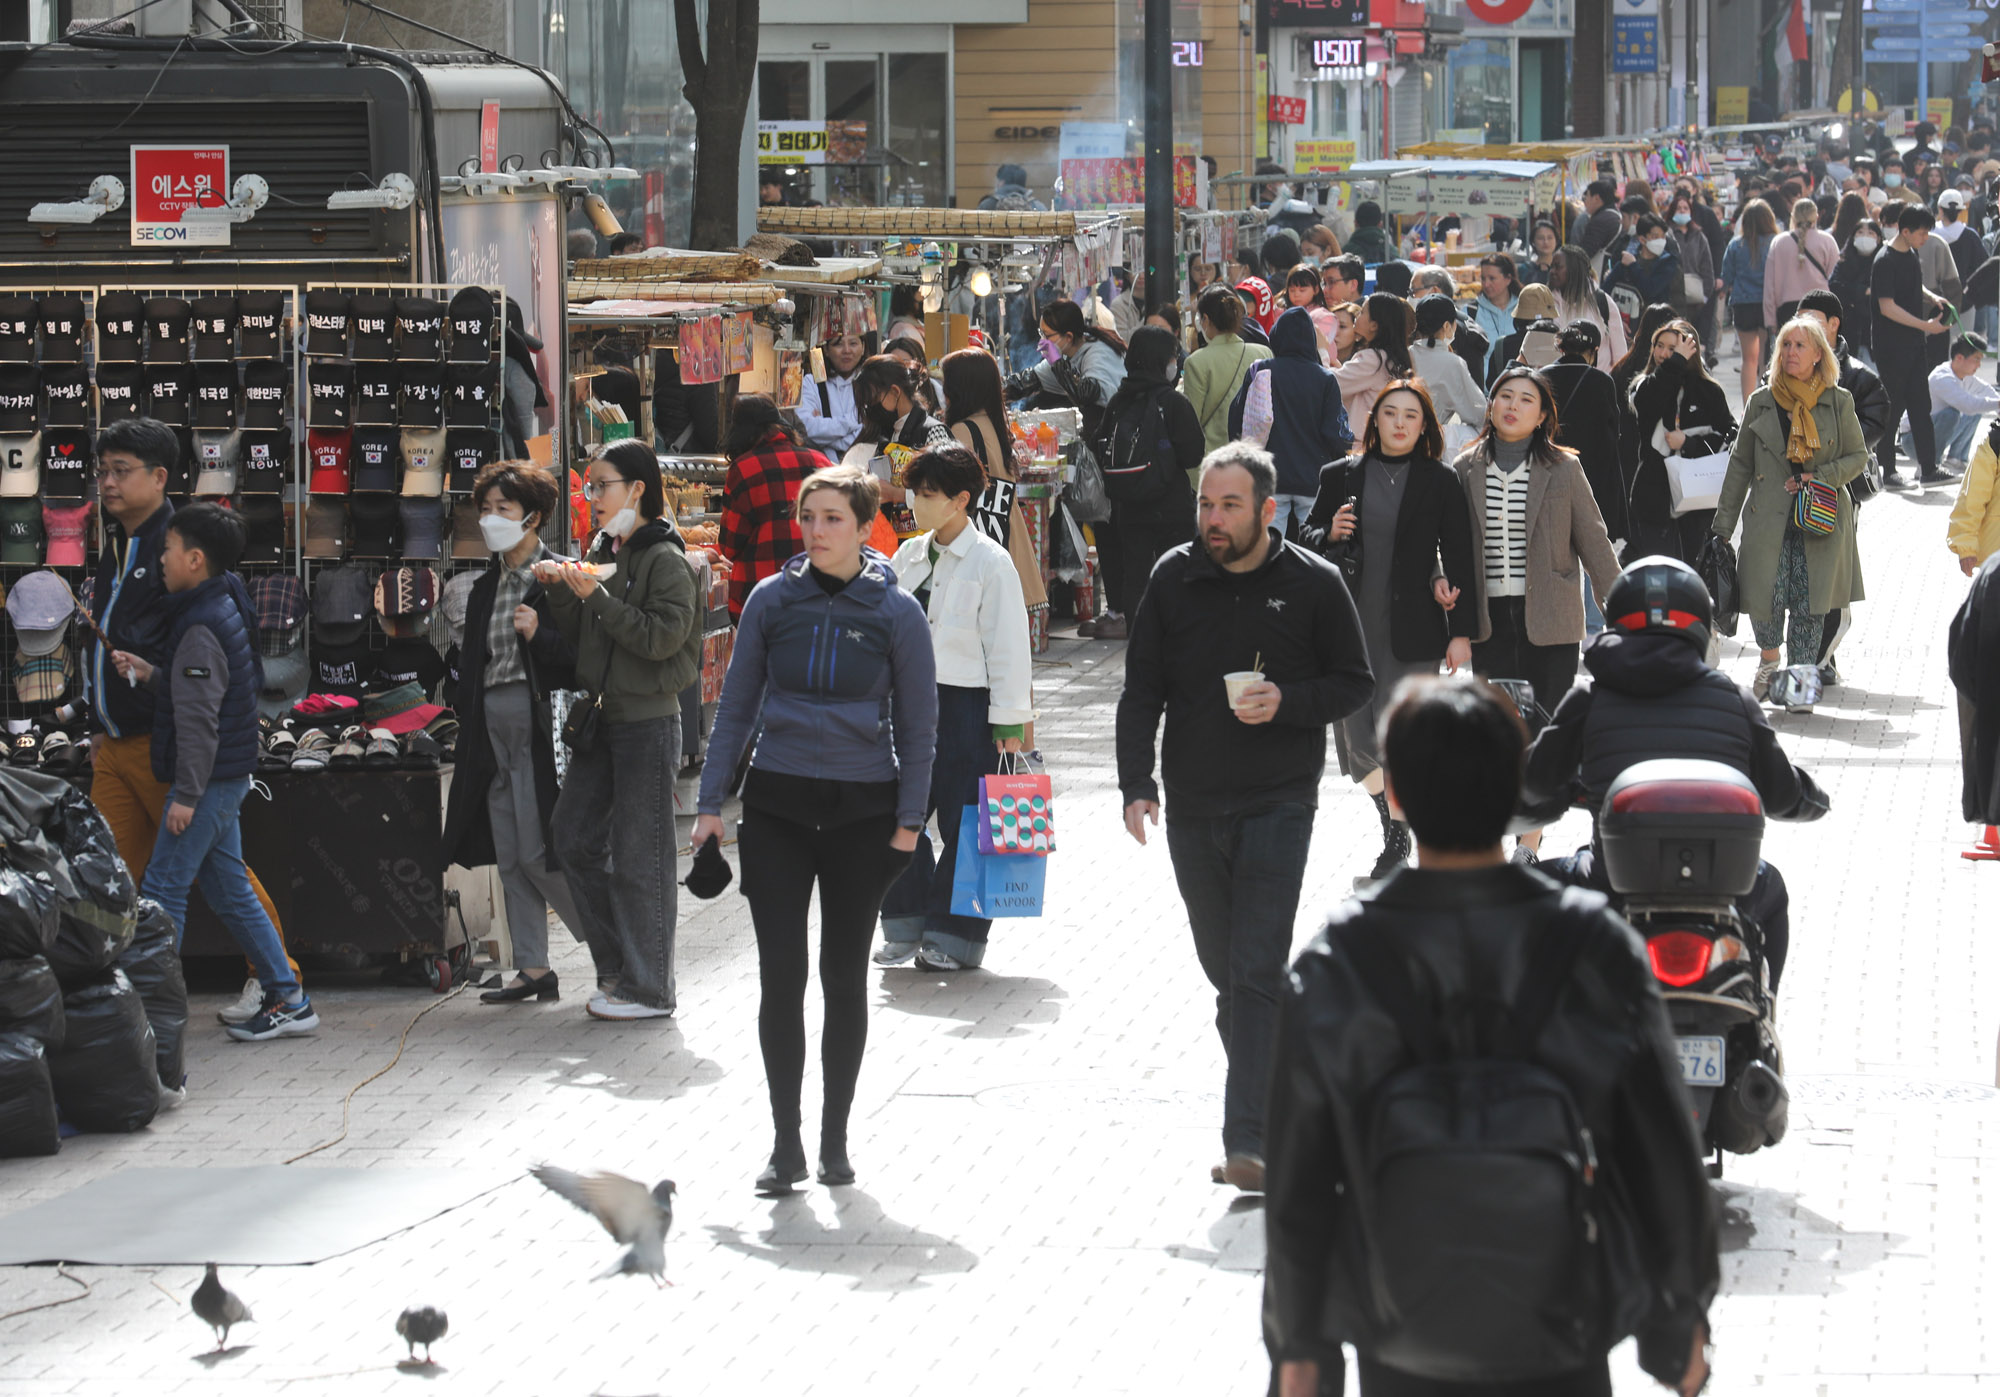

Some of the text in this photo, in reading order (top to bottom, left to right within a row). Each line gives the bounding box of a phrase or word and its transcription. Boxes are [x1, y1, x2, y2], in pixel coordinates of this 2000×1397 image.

[1313, 40, 1362, 66] USDT
[995, 126, 1061, 139] EIDE
[1318, 143, 1355, 153] HELLO
[1319, 155, 1354, 164] Massage
[152, 174, 212, 198] 에스원
[160, 202, 180, 210] CCTV
[136, 227, 187, 240] SECOM
[107, 320, 134, 335] 아빠
[196, 319, 226, 334] 아들
[358, 318, 386, 334] 대박
[455, 319, 482, 335] 대장
[152, 381, 178, 398] 친구
[199, 386, 229, 401] 외국인
[246, 386, 282, 401] 대한민국
[362, 383, 390, 398] 최고
[455, 385, 485, 401] 서울
[314, 445, 342, 456] KOREA
[361, 443, 388, 452] KOREA
[407, 447, 434, 456] KOREA
[454, 448, 483, 458] KOREA
[8, 449, 23, 469] C
[46, 458, 83, 469] Korea
[1005, 882, 1029, 893] FIND
[994, 896, 1036, 908] KAPOOR
